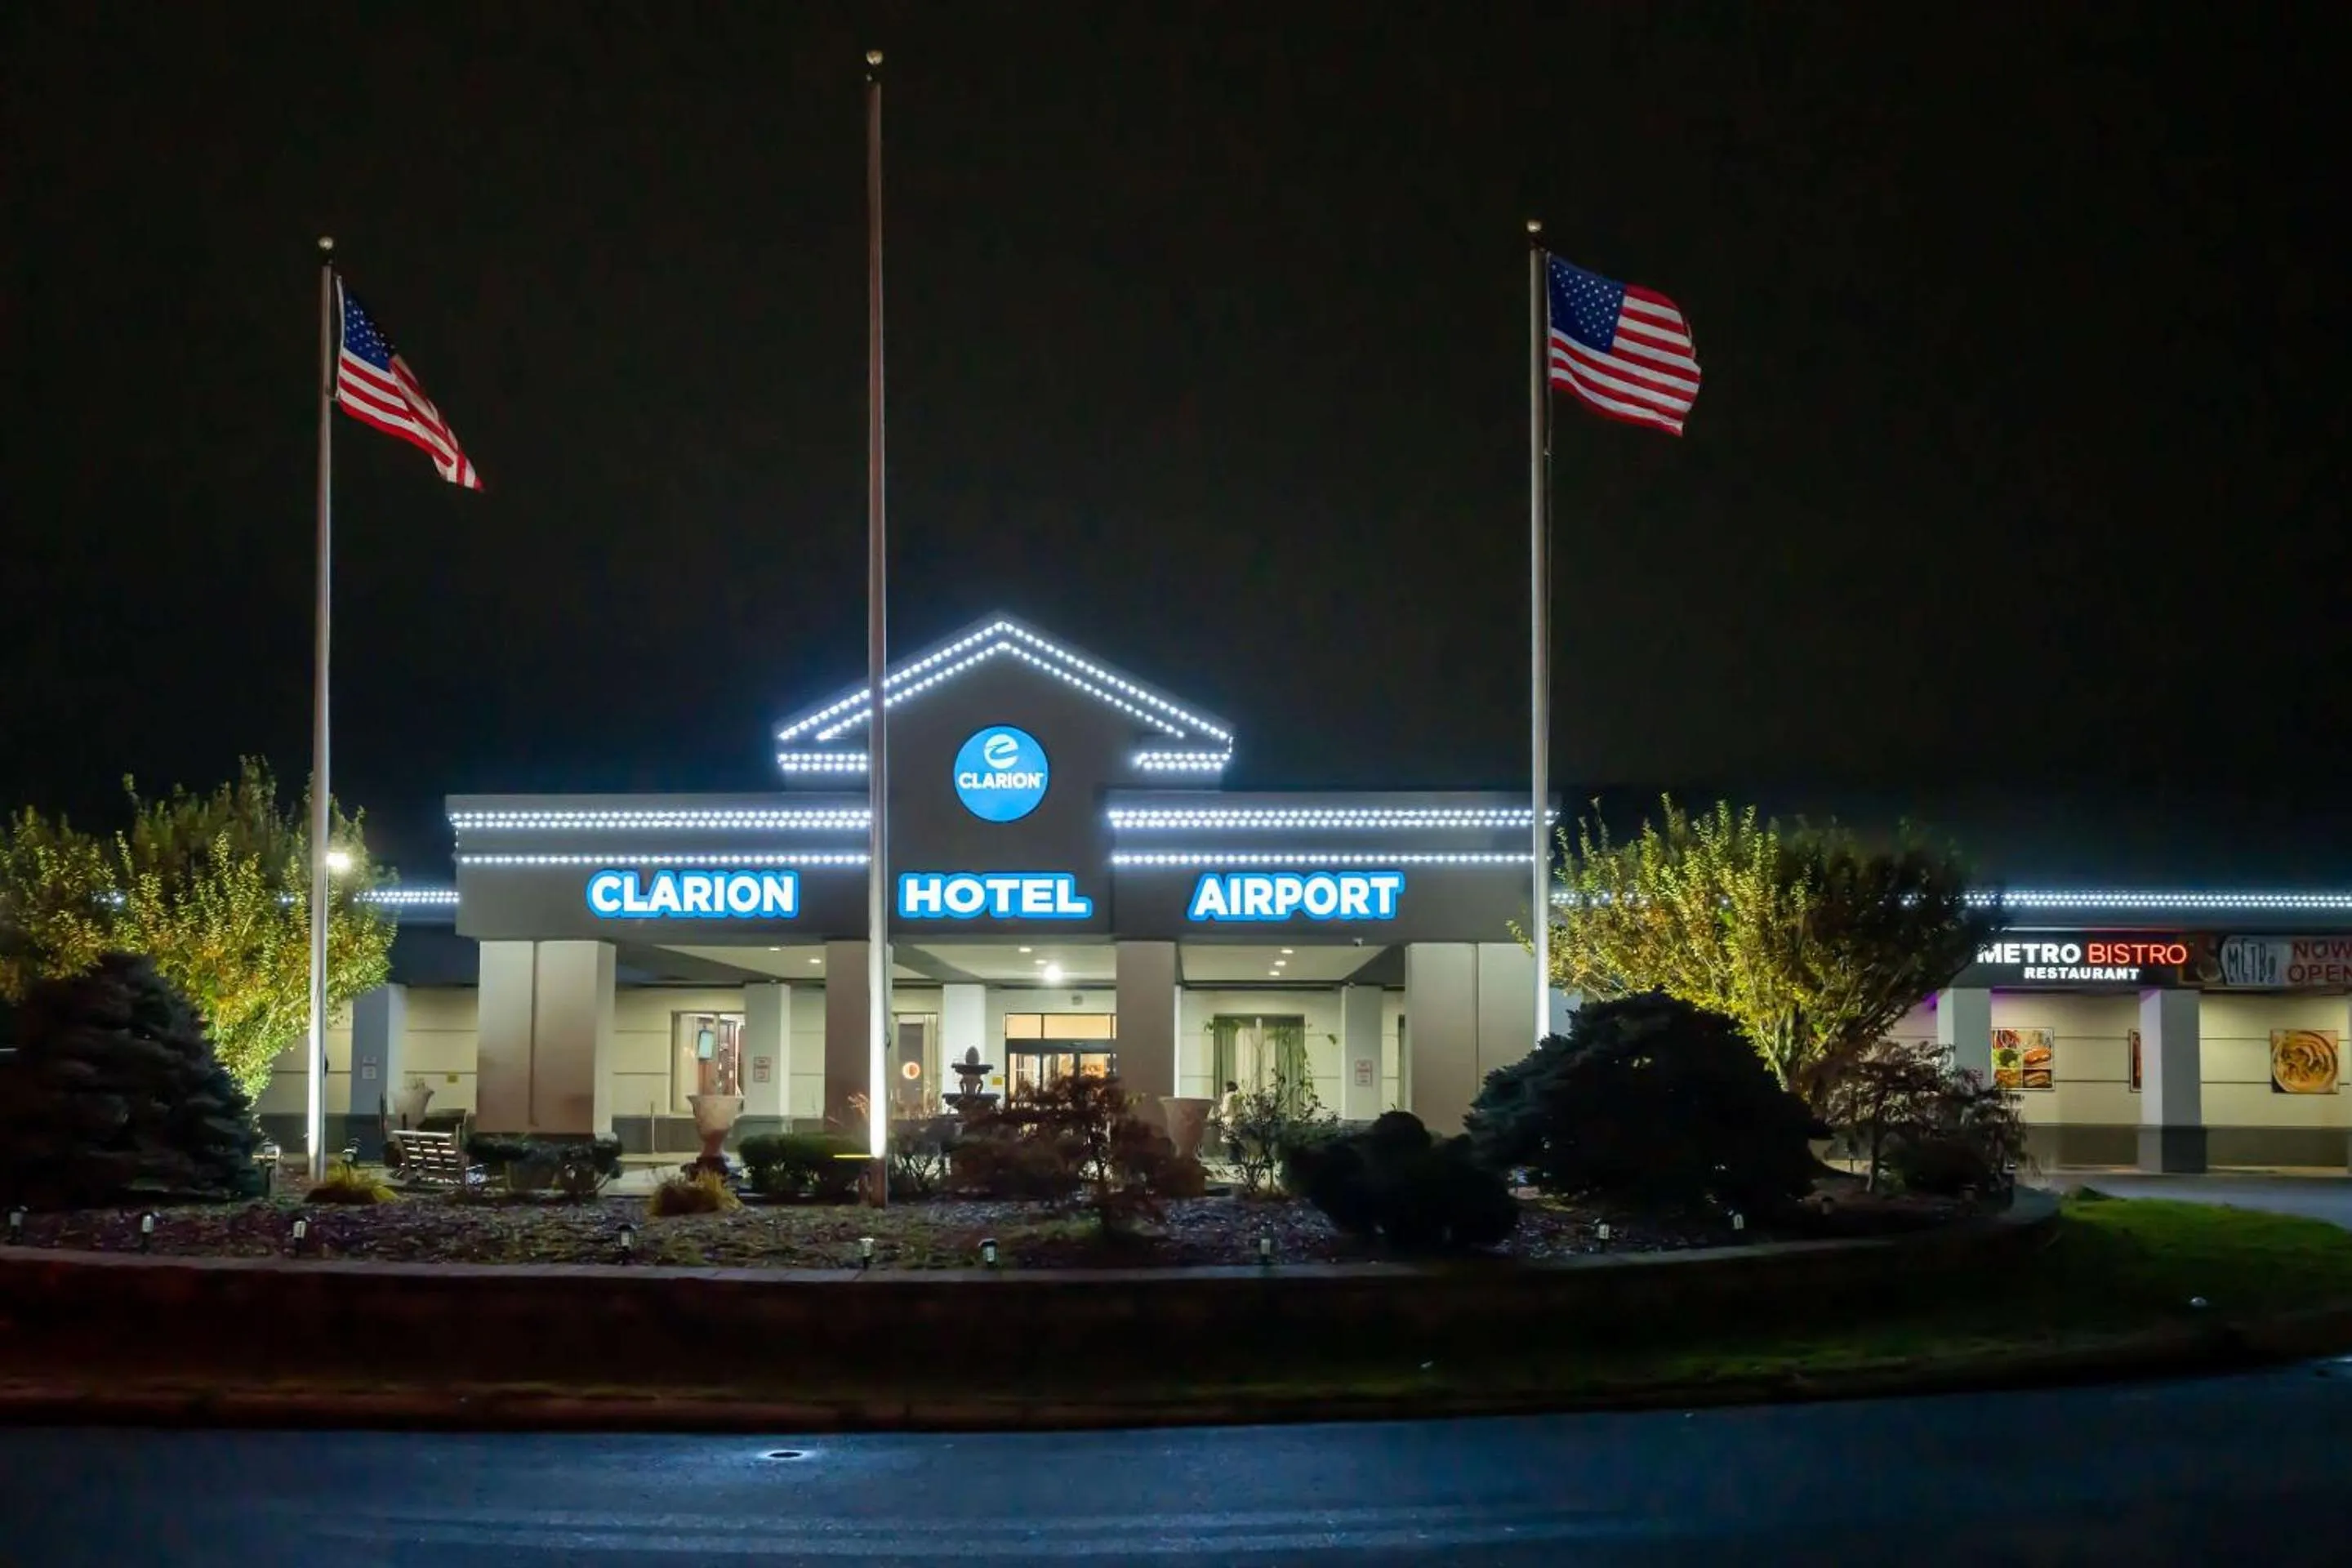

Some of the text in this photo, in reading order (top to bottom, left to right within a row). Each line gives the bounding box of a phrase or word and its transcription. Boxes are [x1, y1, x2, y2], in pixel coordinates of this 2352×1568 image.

[959, 773, 1041, 789] CLARION
[592, 875, 1400, 915] CLARION HOTEL AIRPORT
[1976, 943, 2188, 964] METRO BISTRO
[2292, 940, 2352, 959] NOW
[2024, 967, 2140, 981] RESTAURANT
